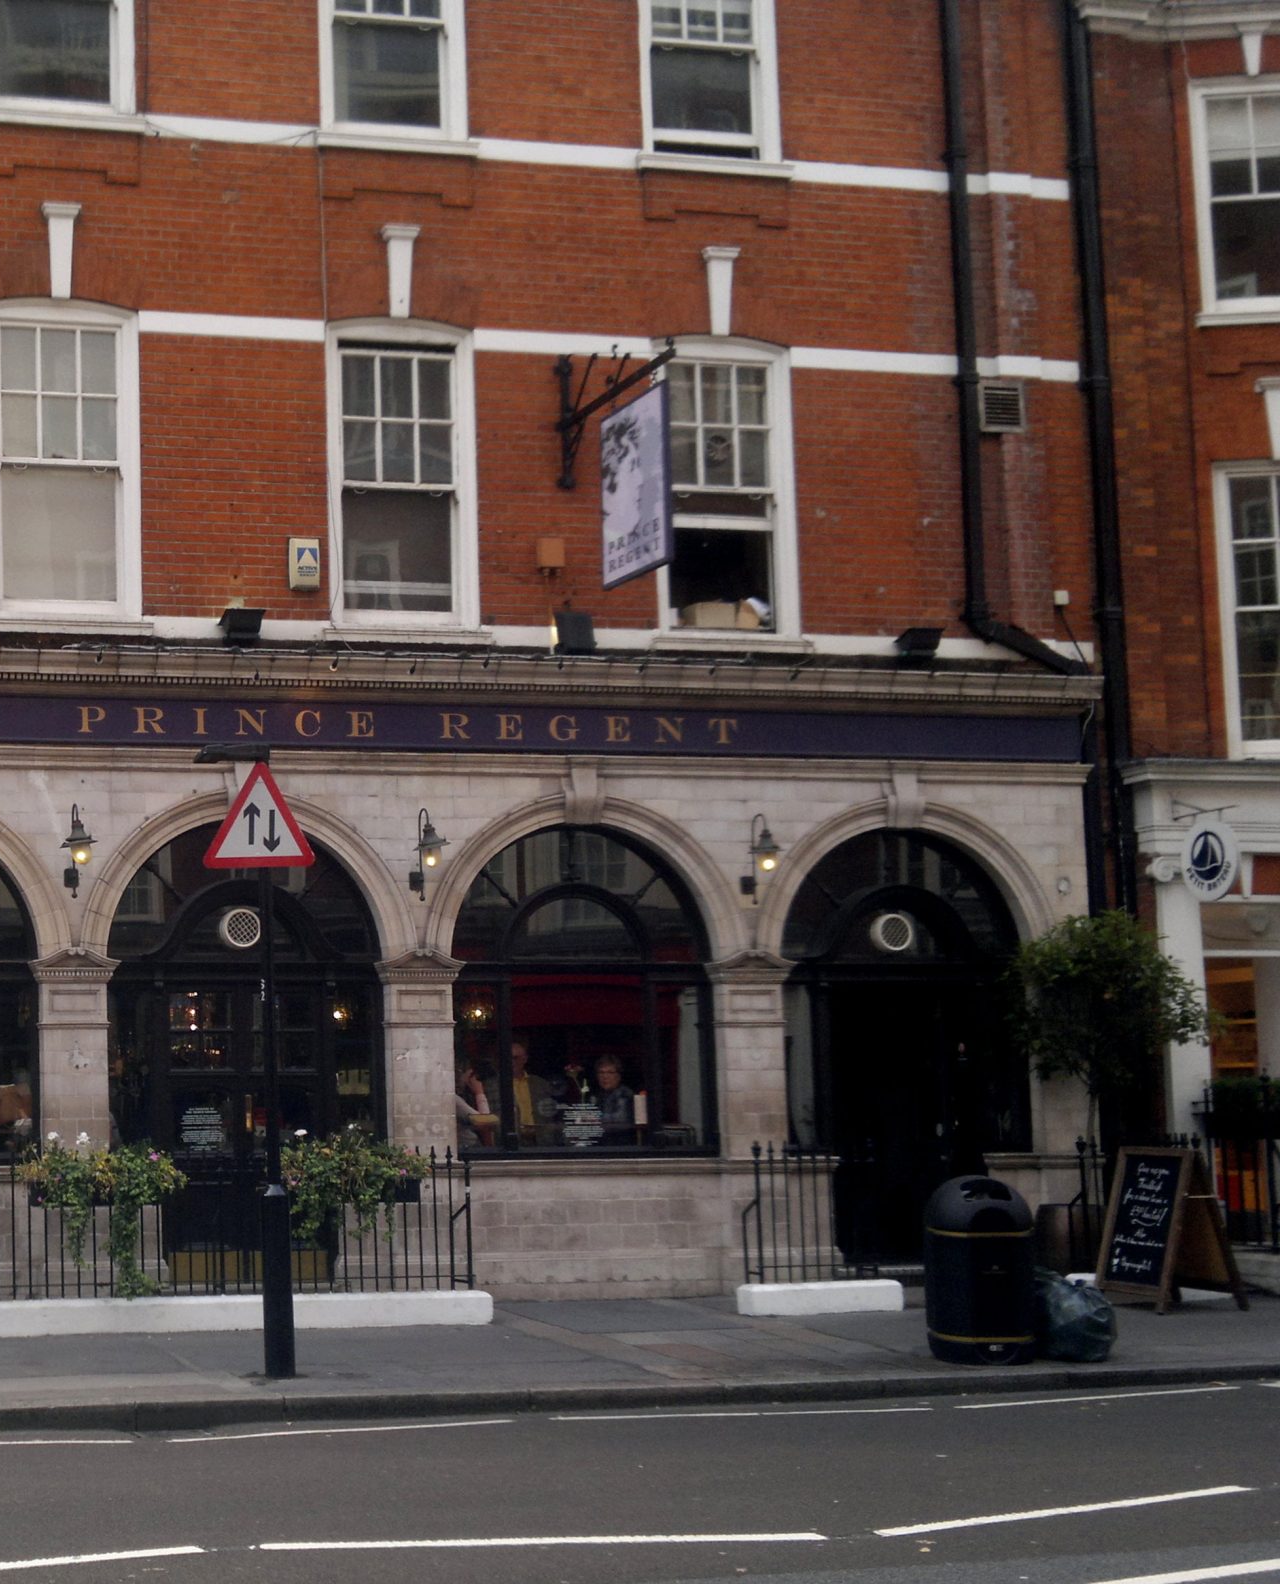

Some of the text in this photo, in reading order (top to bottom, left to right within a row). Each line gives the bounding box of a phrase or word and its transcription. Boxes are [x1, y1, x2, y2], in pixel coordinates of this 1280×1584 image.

[608, 517, 661, 555] PRINCE
[609, 537, 661, 573] REGENT
[77, 706, 738, 744] PRINCE REGENT
[1186, 861, 1231, 891] PETIT BATEAU
